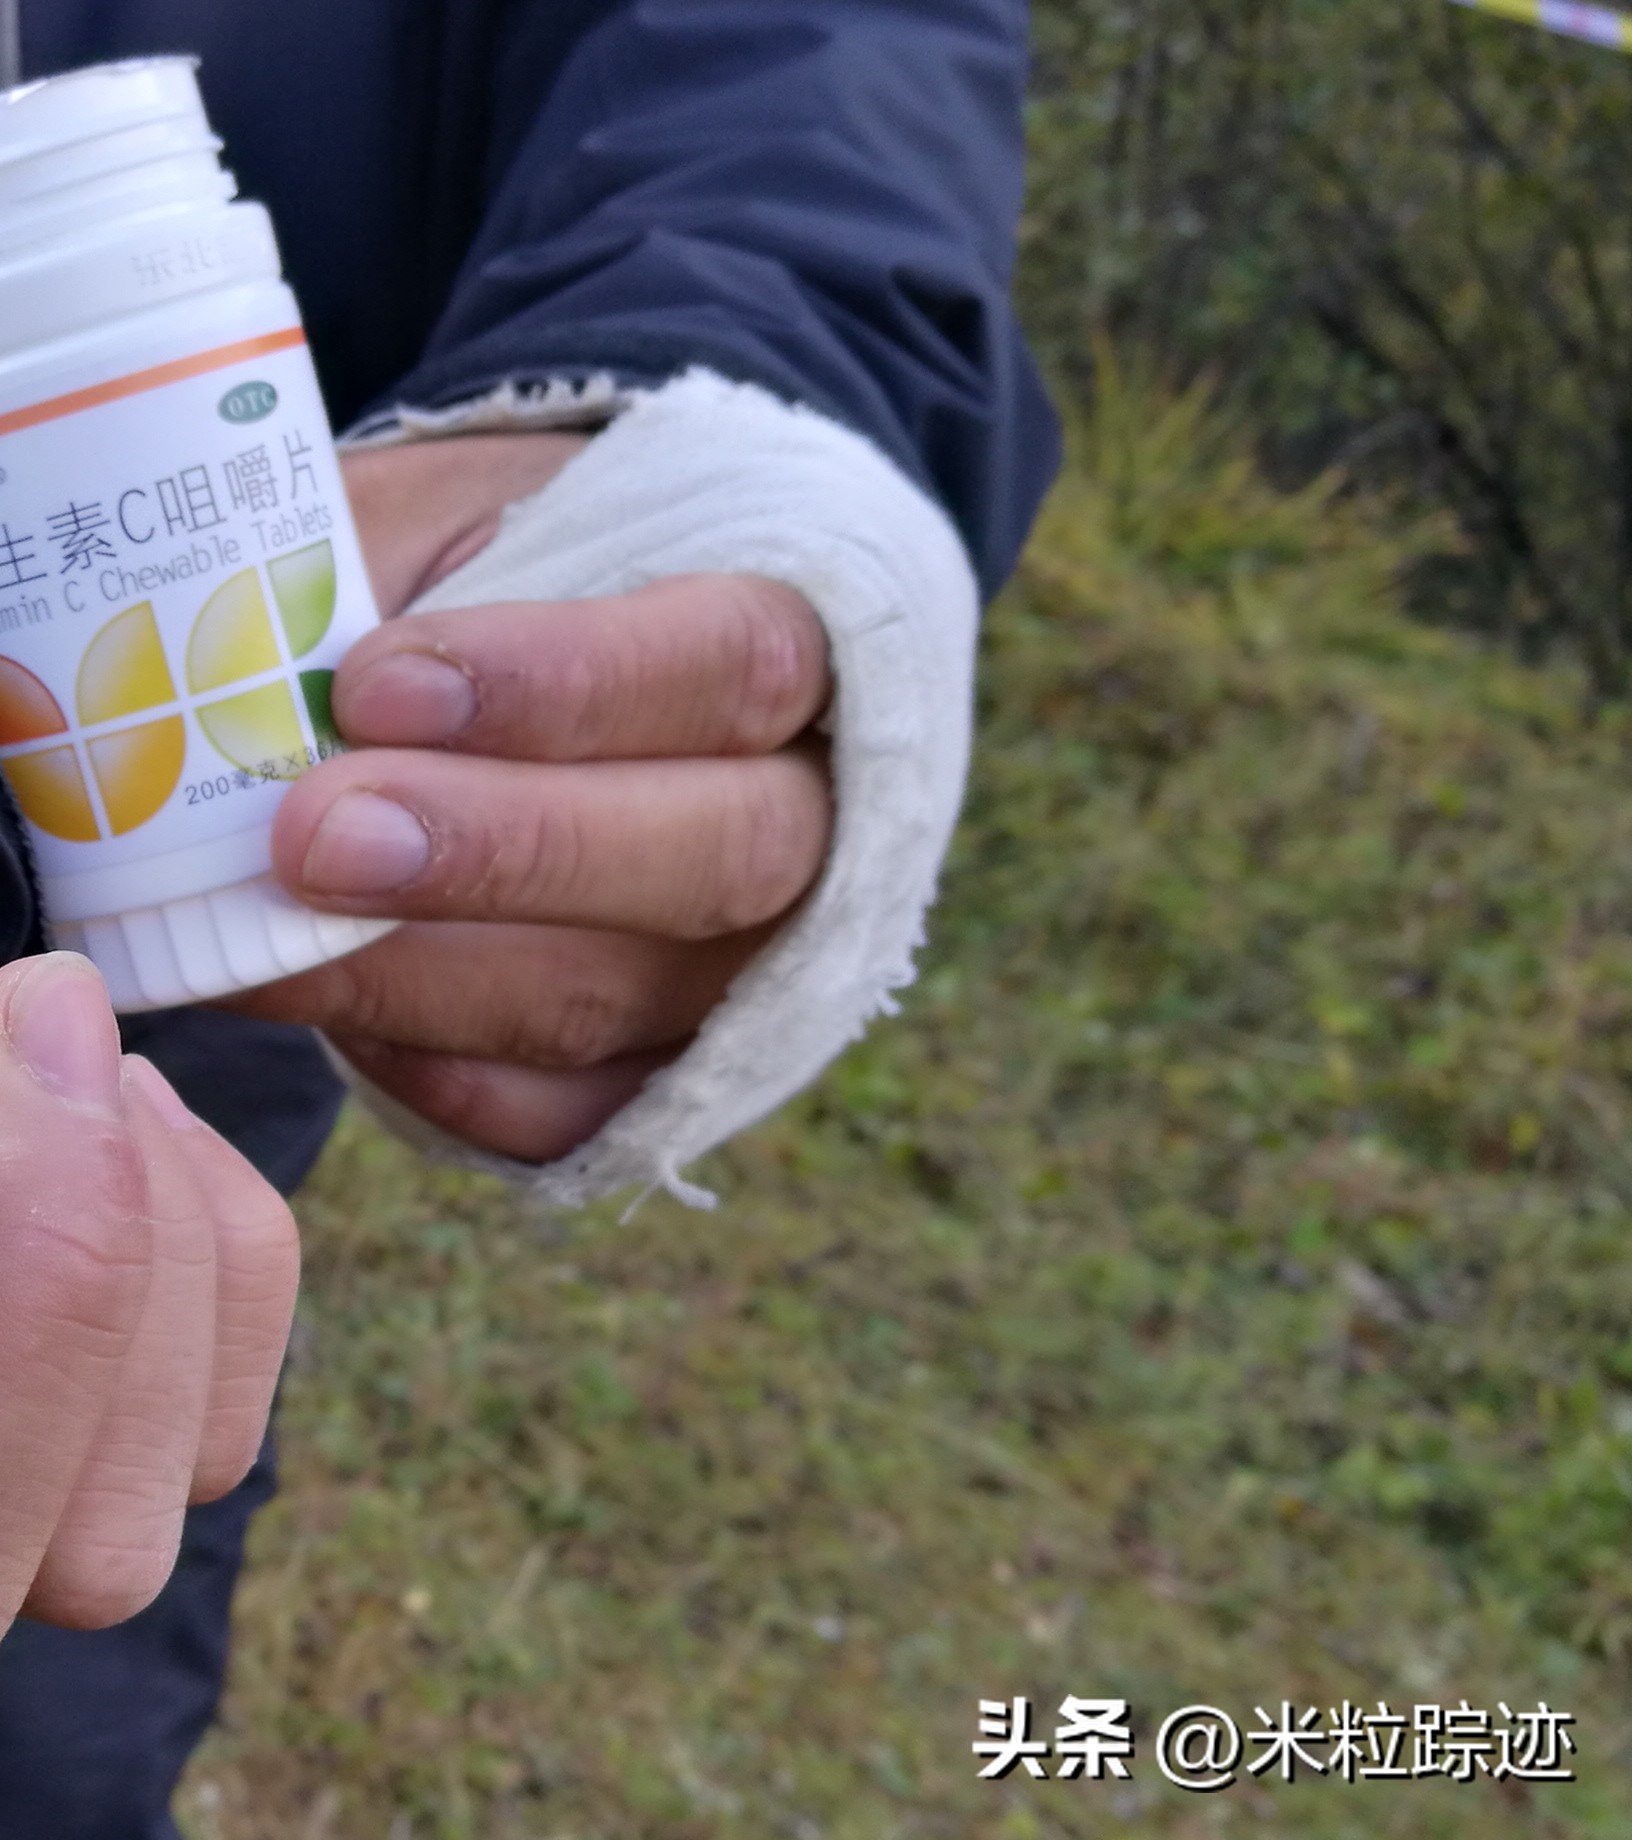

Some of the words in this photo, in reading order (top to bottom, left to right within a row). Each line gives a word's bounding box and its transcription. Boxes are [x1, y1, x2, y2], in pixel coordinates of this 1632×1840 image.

[227, 386, 275, 418] OTC
[62, 581, 86, 613] C
[98, 535, 242, 602] Chewable
[251, 501, 334, 554] Tablets
